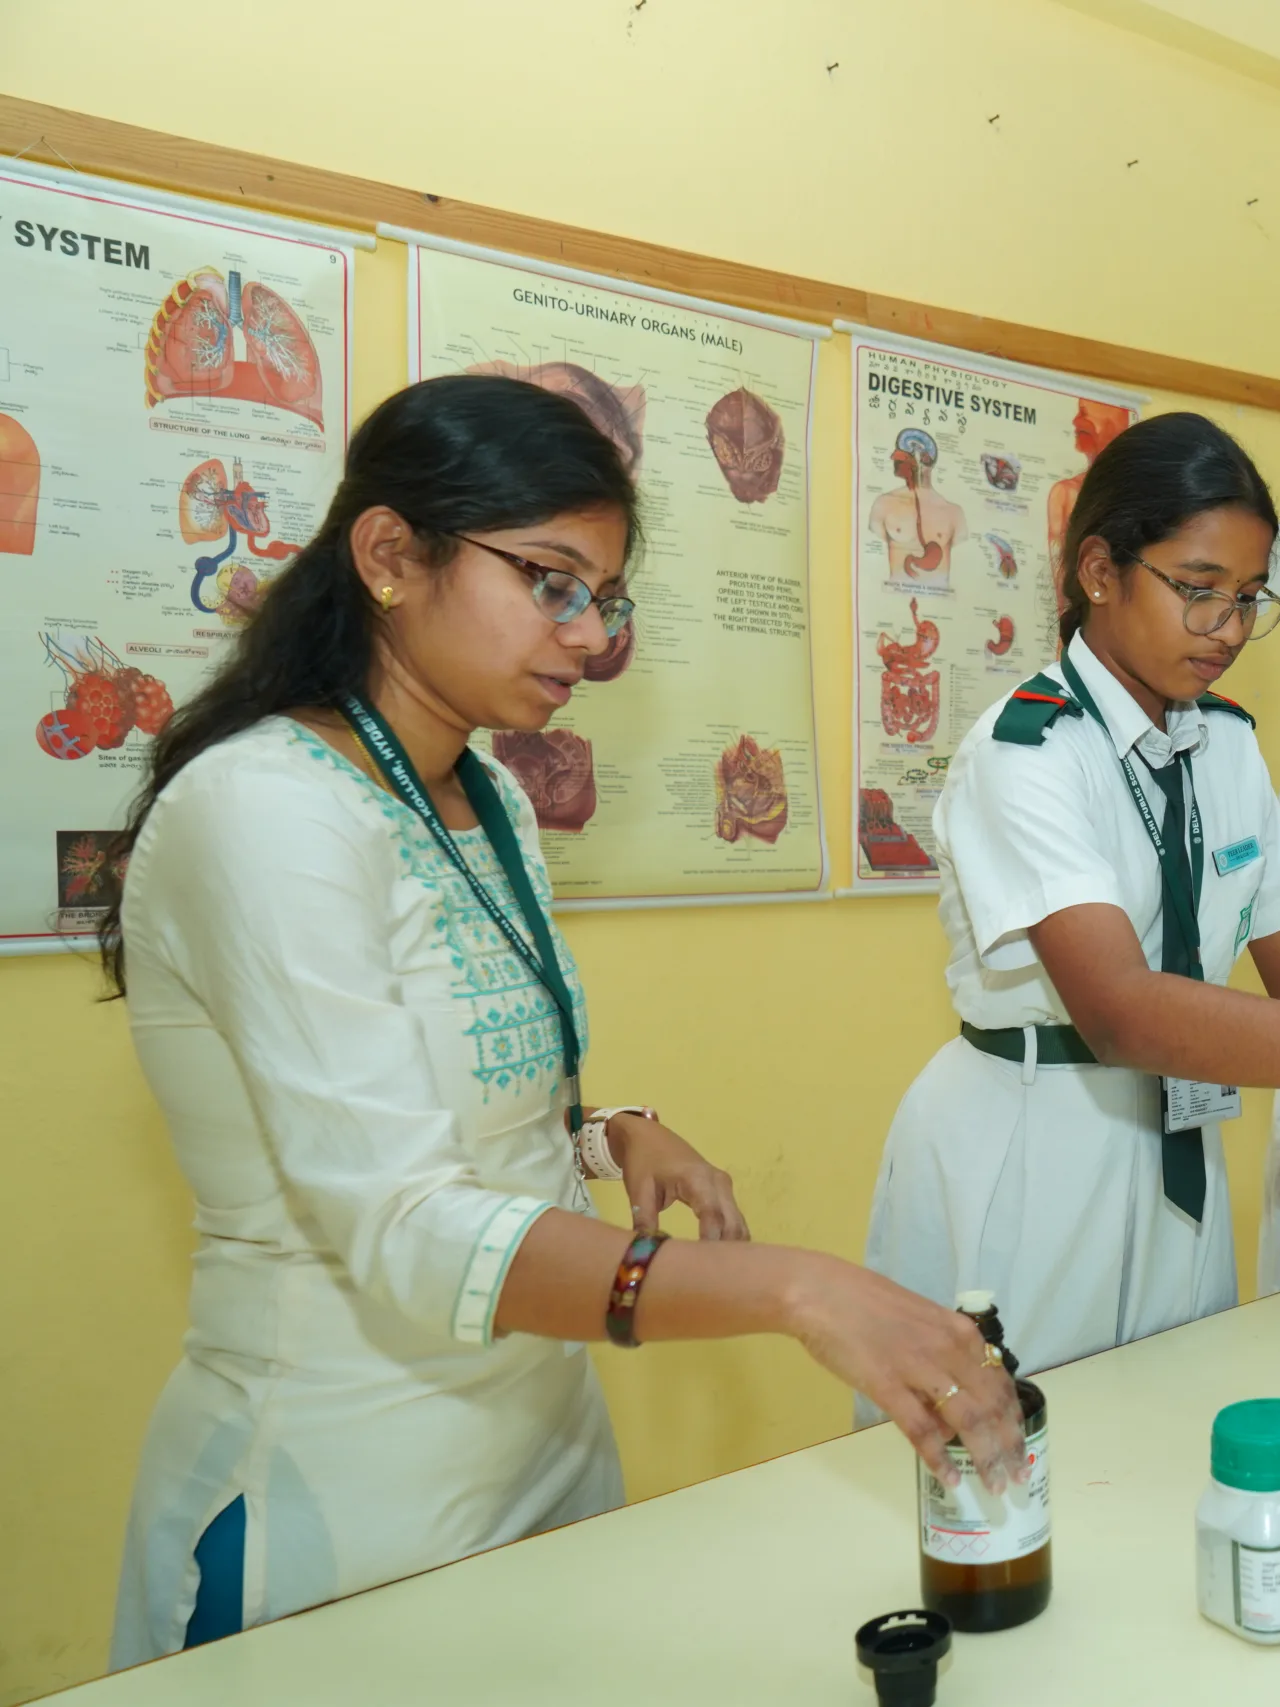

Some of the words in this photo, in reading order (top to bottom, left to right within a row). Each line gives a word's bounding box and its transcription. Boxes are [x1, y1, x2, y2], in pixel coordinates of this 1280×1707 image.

[14, 220, 151, 270] SYSTEM
[329, 254, 337, 264] 9
[512, 287, 636, 328] GENITO-URINARY
[640, 317, 697, 342] ORGANS
[700, 331, 744, 355] (MALE)
[868, 352, 917, 367] HUMAN
[924, 364, 1008, 389] PHYSIOLOGY
[868, 372, 965, 409] DIGESTIVE
[970, 394, 1037, 425] SYSTEM
[153, 421, 199, 433] STRUCTURE
[201, 428, 212, 436] OF
[213, 429, 228, 438] THE
[229, 431, 250, 440] LUNG
[716, 570, 748, 580] ANTERIOR
[750, 574, 766, 582] VIEW
[729, 580, 761, 590] PROSTATE
[762, 583, 775, 592] AND
[718, 587, 744, 597] OPENED
[746, 590, 755, 598] TO
[756, 592, 774, 600] SHOW
[716, 596, 729, 604] THE
[730, 598, 746, 606] LEFT
[748, 599, 776, 609] TESTICLE
[746, 608, 769, 617] SHOWN
[713, 613, 726, 621] THE
[728, 615, 748, 623] RIGHT
[749, 617, 782, 627] DISSECTED
[722, 623, 735, 631] THE
[736, 625, 767, 634] INTERNAL
[128, 645, 162, 654] ALVEOLI
[98, 754, 117, 762] Sites
[119, 754, 127, 762] of
[128, 756, 141, 764] gas
[391, 759, 432, 818] KOLLUR,
[1134, 787, 1151, 819] PUBLIC
[1147, 819, 1162, 847] DELHI
